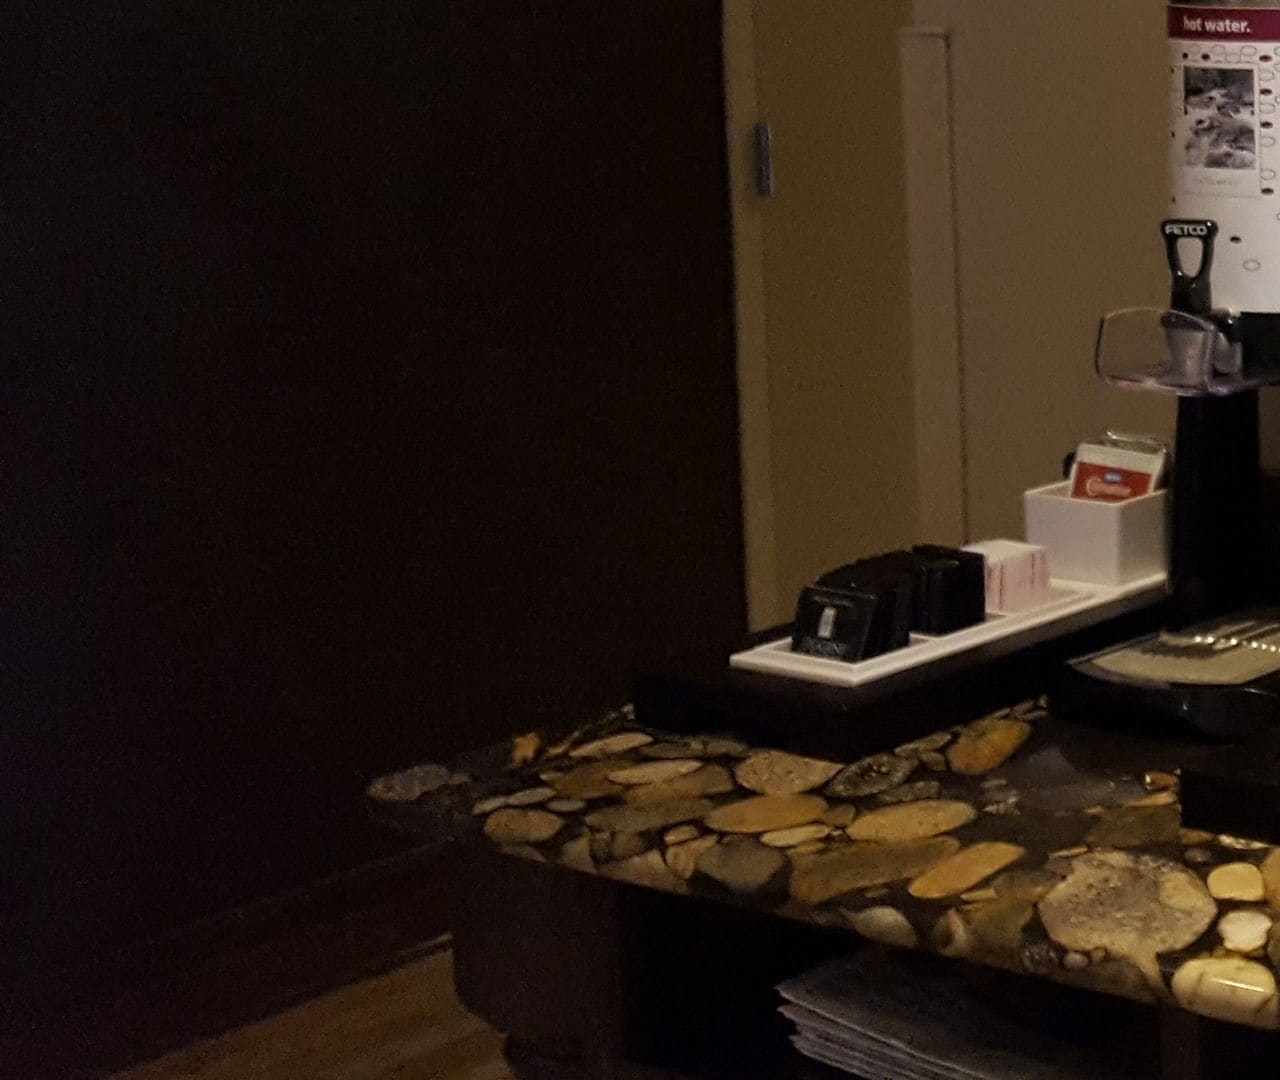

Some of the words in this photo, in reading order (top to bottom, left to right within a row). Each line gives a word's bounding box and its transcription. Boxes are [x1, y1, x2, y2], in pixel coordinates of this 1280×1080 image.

[1183, 15, 1202, 31] hot
[1204, 19, 1251, 33] water.
[1164, 224, 1208, 236] FETCO
